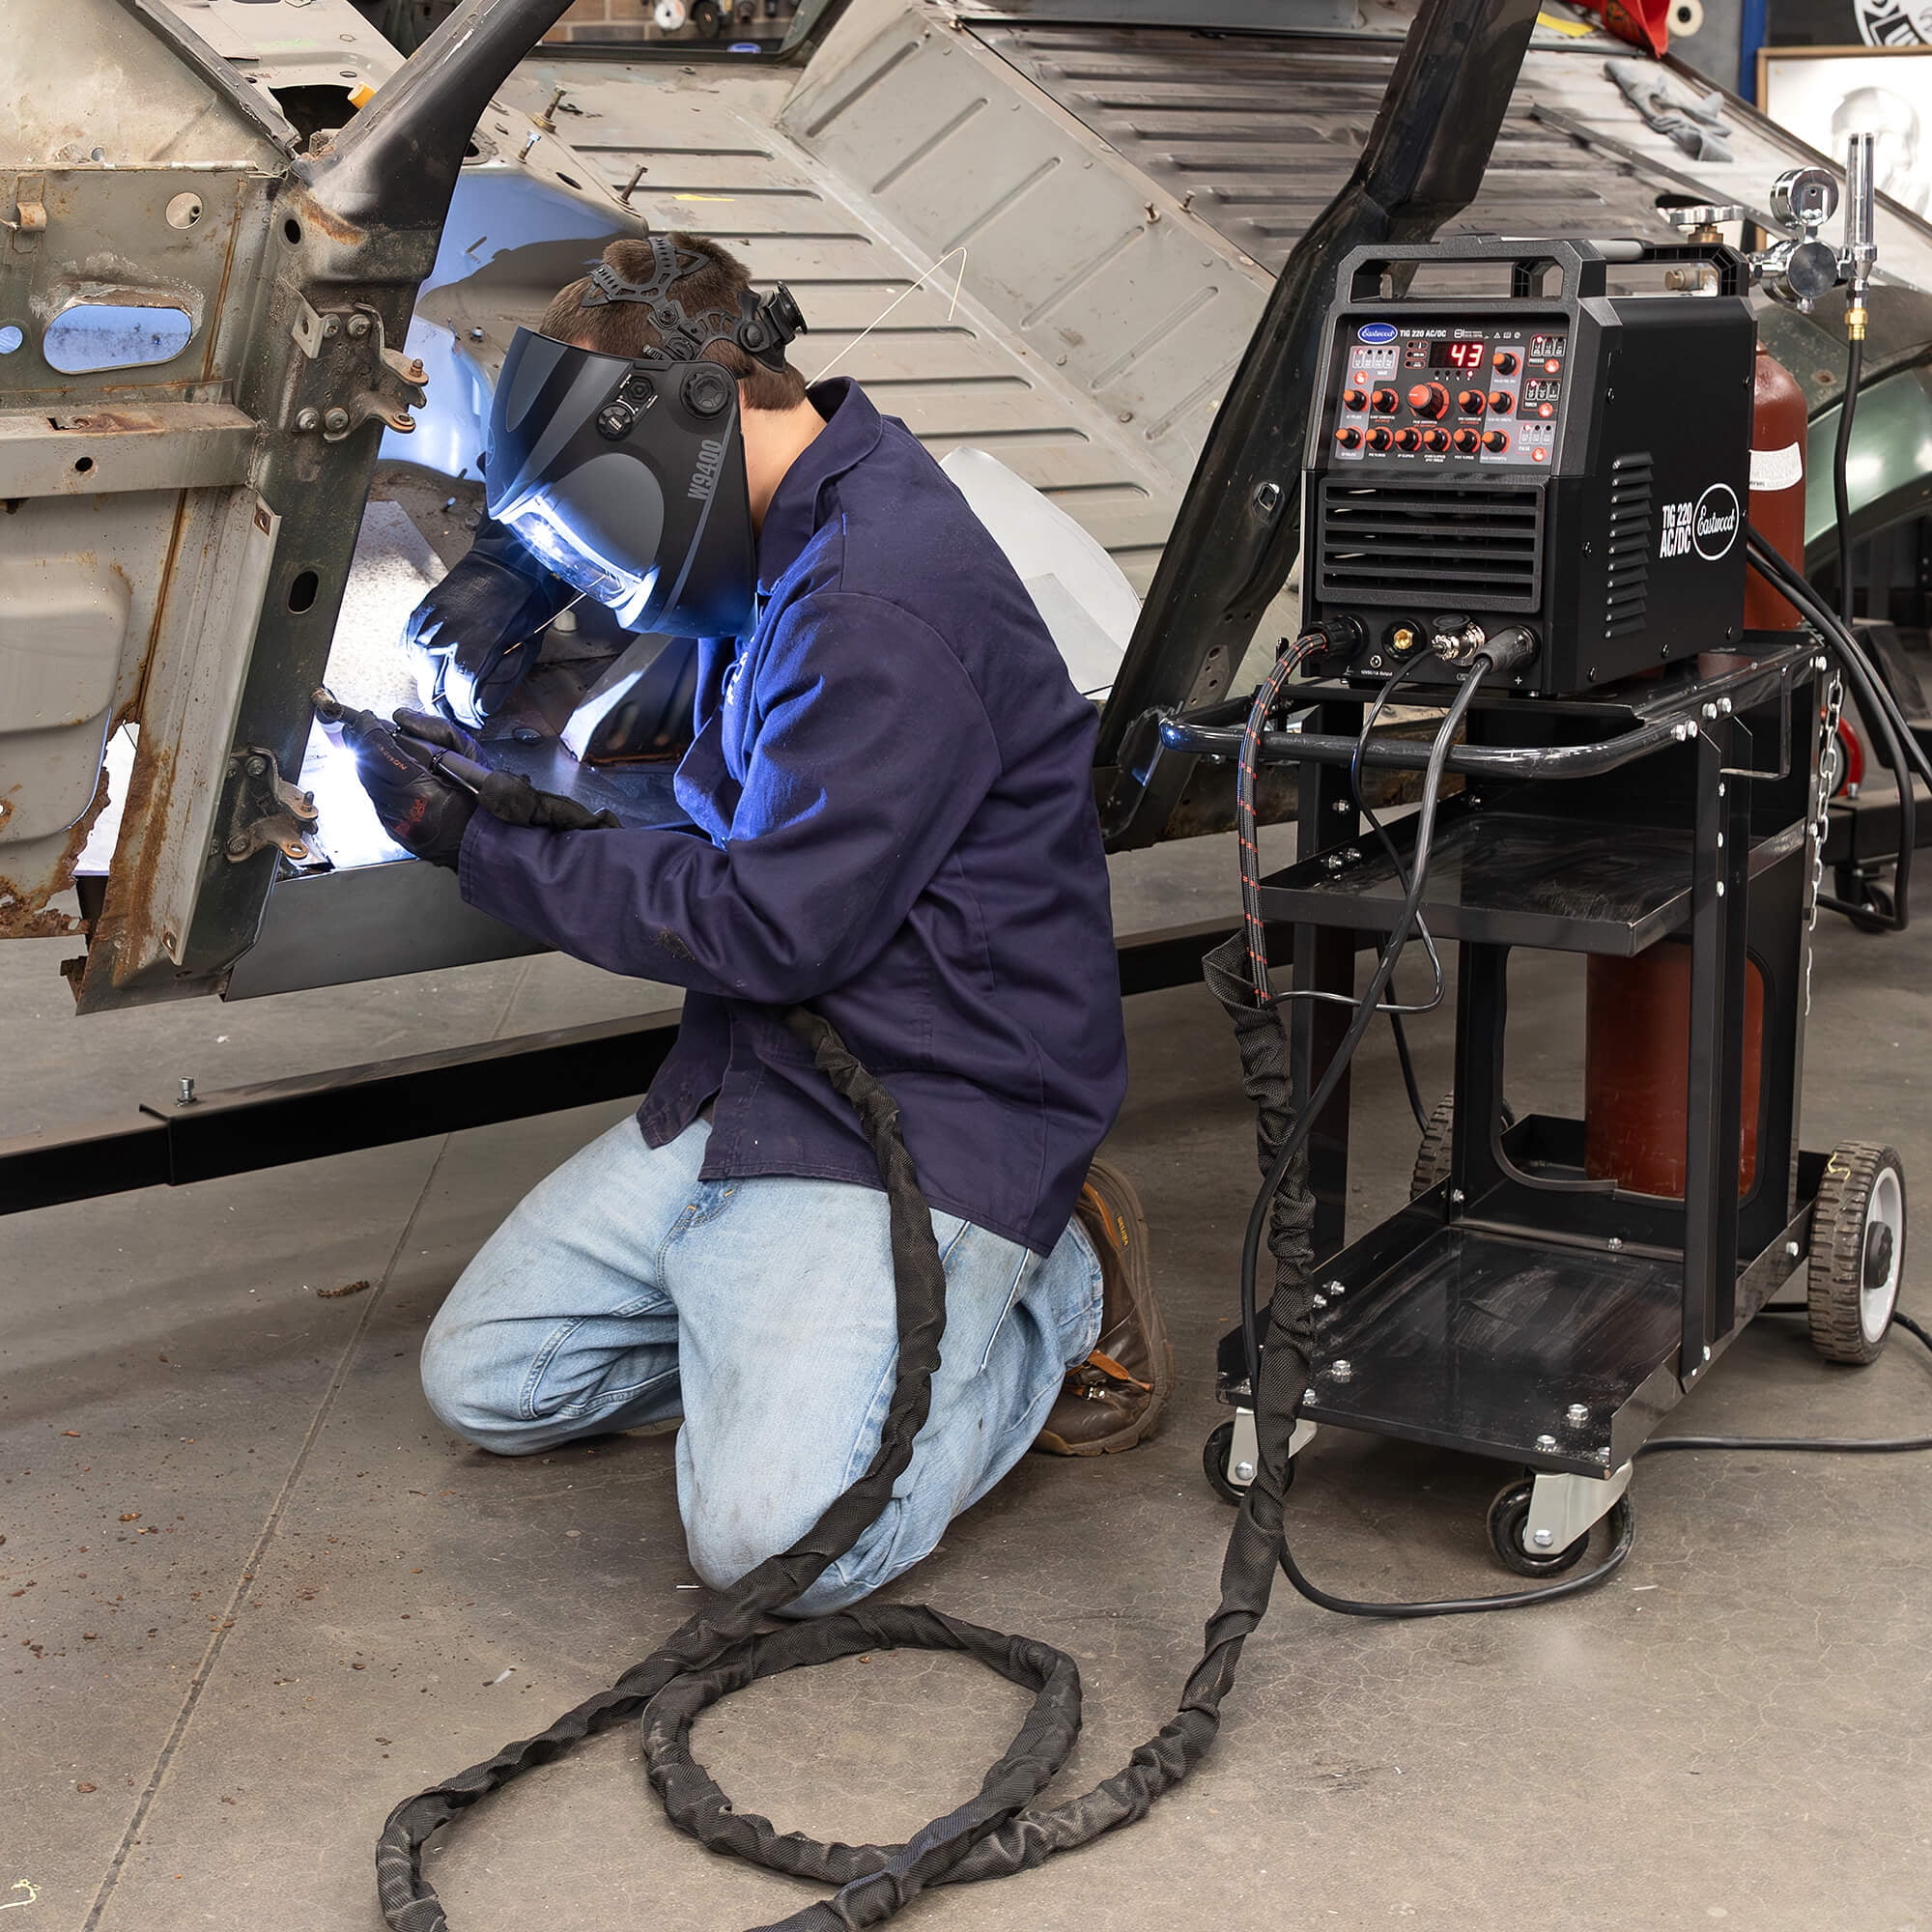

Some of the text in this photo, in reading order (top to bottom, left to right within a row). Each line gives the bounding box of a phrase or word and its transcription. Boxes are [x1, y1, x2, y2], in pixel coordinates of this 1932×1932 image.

[1360, 327, 1396, 338] Eastwood
[1425, 329, 1447, 338] AC/DC
[1451, 344, 1484, 367] 43
[687, 440, 723, 500] W9400
[1662, 501, 1692, 528] TIG 220
[1696, 504, 1736, 537] Eastwood
[1659, 525, 1691, 558] AC/DC
